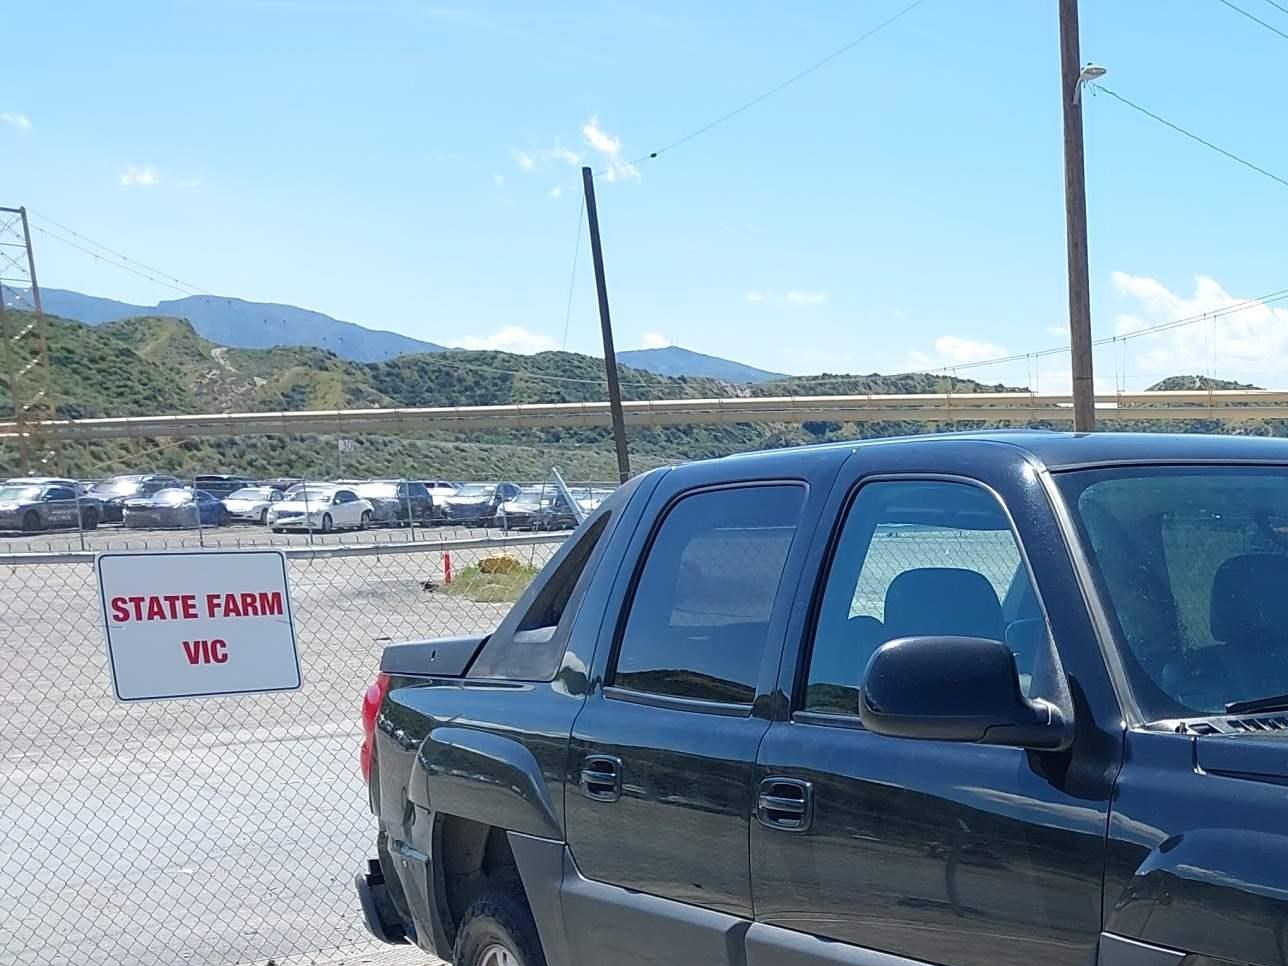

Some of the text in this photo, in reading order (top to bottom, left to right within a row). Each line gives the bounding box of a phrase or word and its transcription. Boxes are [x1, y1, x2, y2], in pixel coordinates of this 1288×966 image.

[111, 591, 284, 623] STATE FARM
[182, 639, 229, 665] VIC
